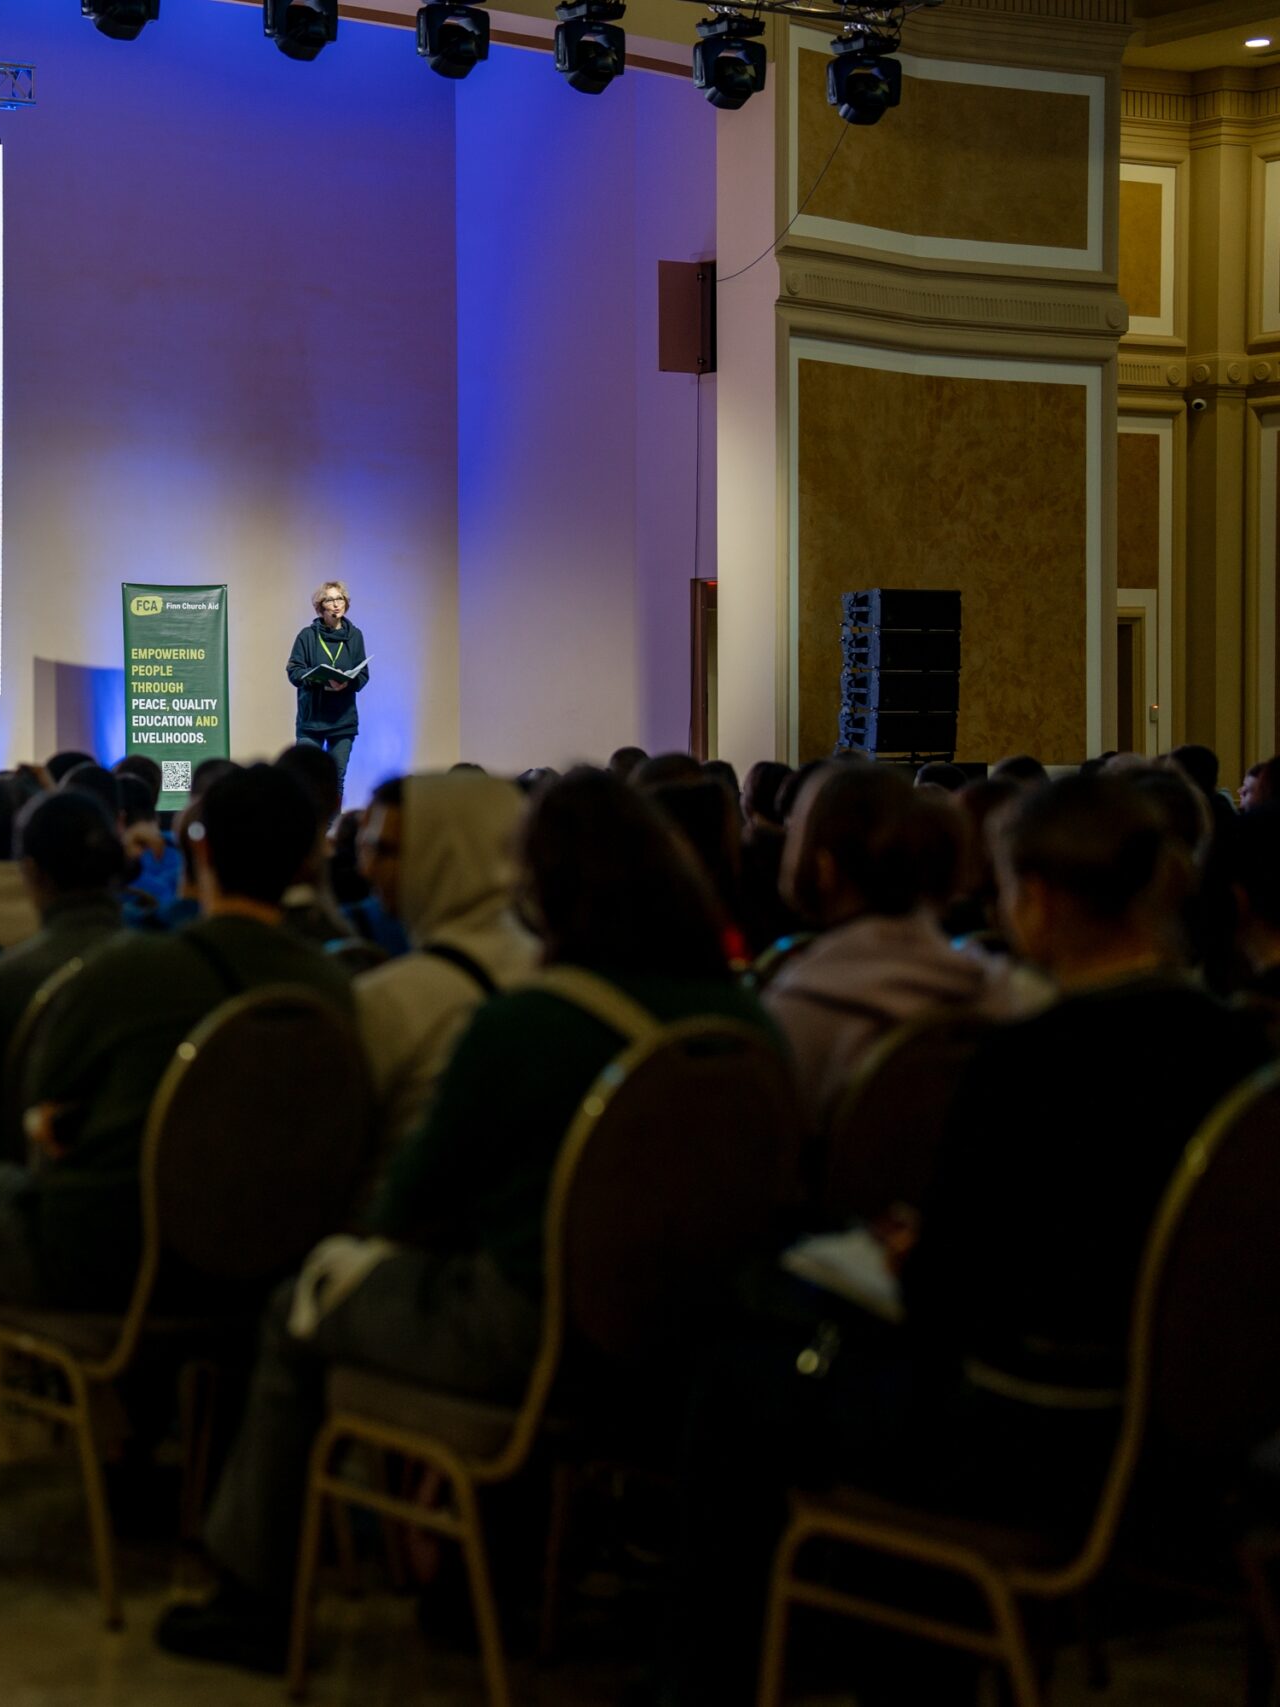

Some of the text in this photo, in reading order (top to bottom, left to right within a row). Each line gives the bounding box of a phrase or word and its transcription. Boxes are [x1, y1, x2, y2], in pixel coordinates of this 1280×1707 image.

[136, 600, 158, 611] FCA
[166, 602, 220, 610] Finn Church Aid
[131, 648, 206, 660] EMPOWERING
[131, 665, 173, 676] PEOPLE
[131, 682, 184, 693] THROUGH
[132, 698, 218, 712] PEACE, QUALITY
[132, 716, 219, 727] EDUCATION AND
[132, 732, 207, 744] LIVELIHOODS.
